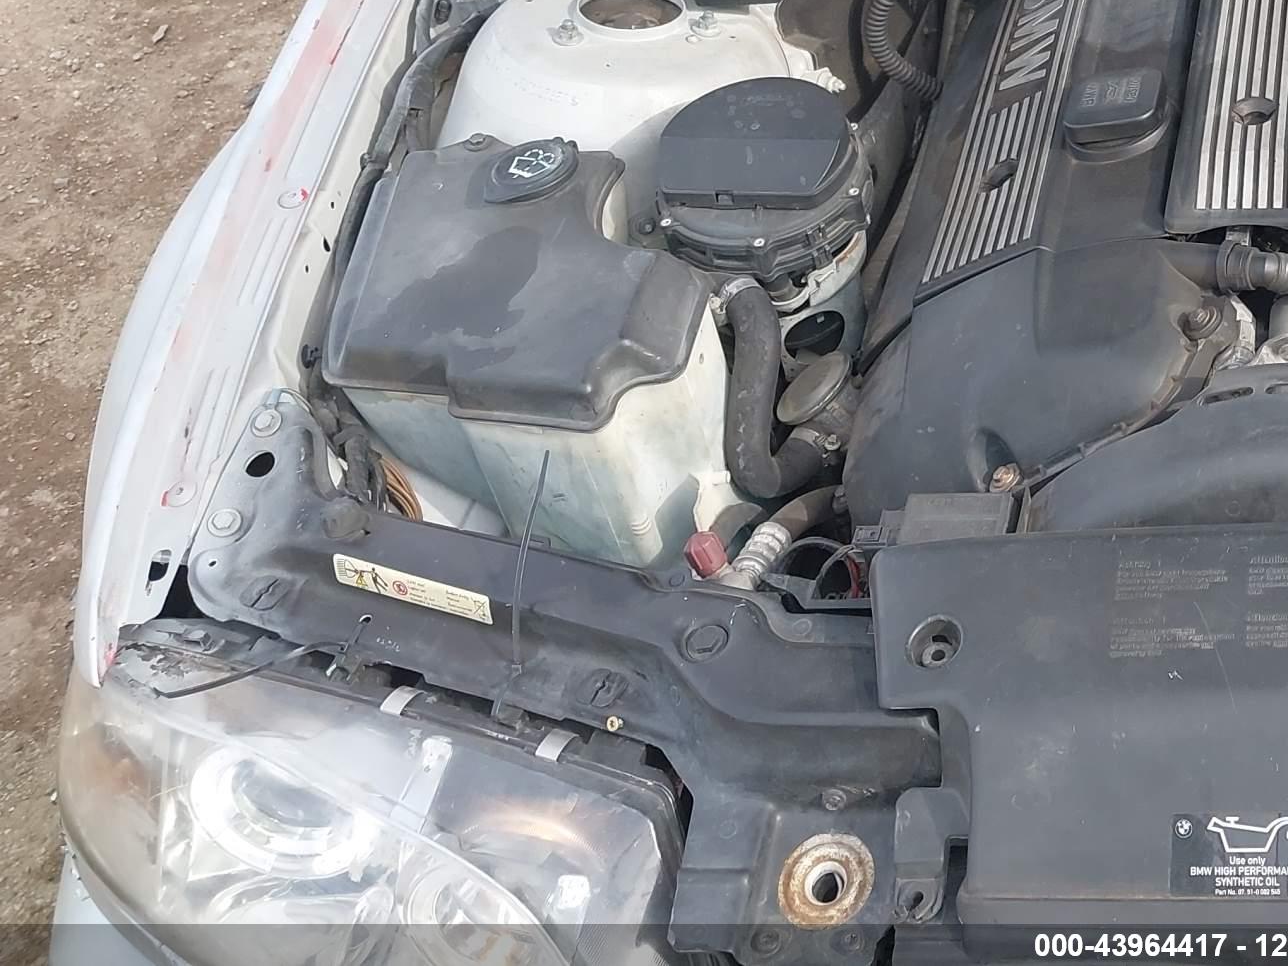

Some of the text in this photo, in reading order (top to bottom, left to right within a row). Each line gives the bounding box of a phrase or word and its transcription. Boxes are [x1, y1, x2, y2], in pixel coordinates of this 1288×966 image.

[1229, 856, 1267, 866] Use only
[1190, 866, 1213, 876] BMW
[1214, 866, 1237, 876] HIGH
[1215, 877, 1280, 887] SYNTHETIC OIL
